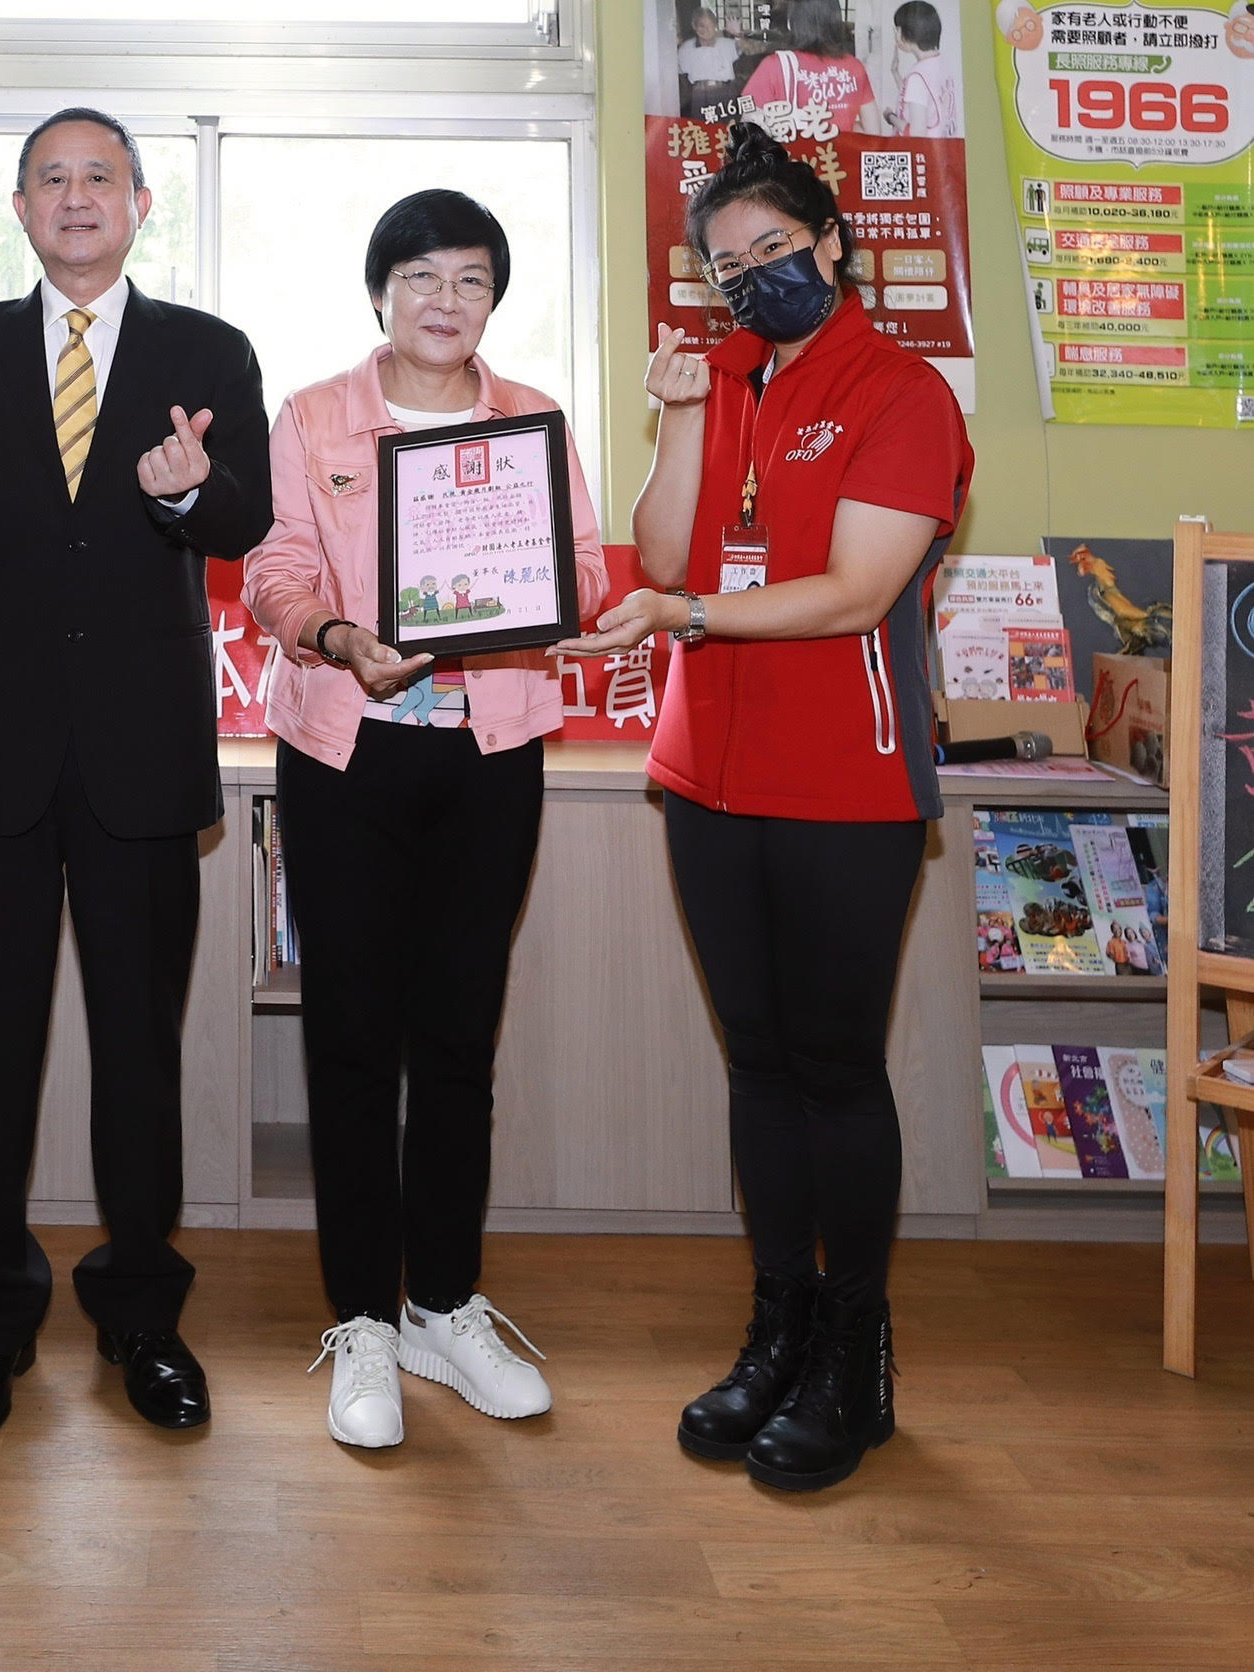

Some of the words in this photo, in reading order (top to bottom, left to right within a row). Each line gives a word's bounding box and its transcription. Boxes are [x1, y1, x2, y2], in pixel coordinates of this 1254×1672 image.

[1051, 11, 1188, 29] 家有老人或行動不便
[1051, 30, 1219, 49] 需要照顧者，請立即撥打
[1055, 53, 1149, 72] 長照服務專線
[700, 94, 756, 125] 第16屆
[1049, 78, 1229, 133] 1966
[1059, 184, 1163, 203] 照顧及專業服務
[1065, 346, 1123, 363] 喘息服務
[785, 449, 813, 461] OFO
[433, 455, 515, 481] 感謝狀
